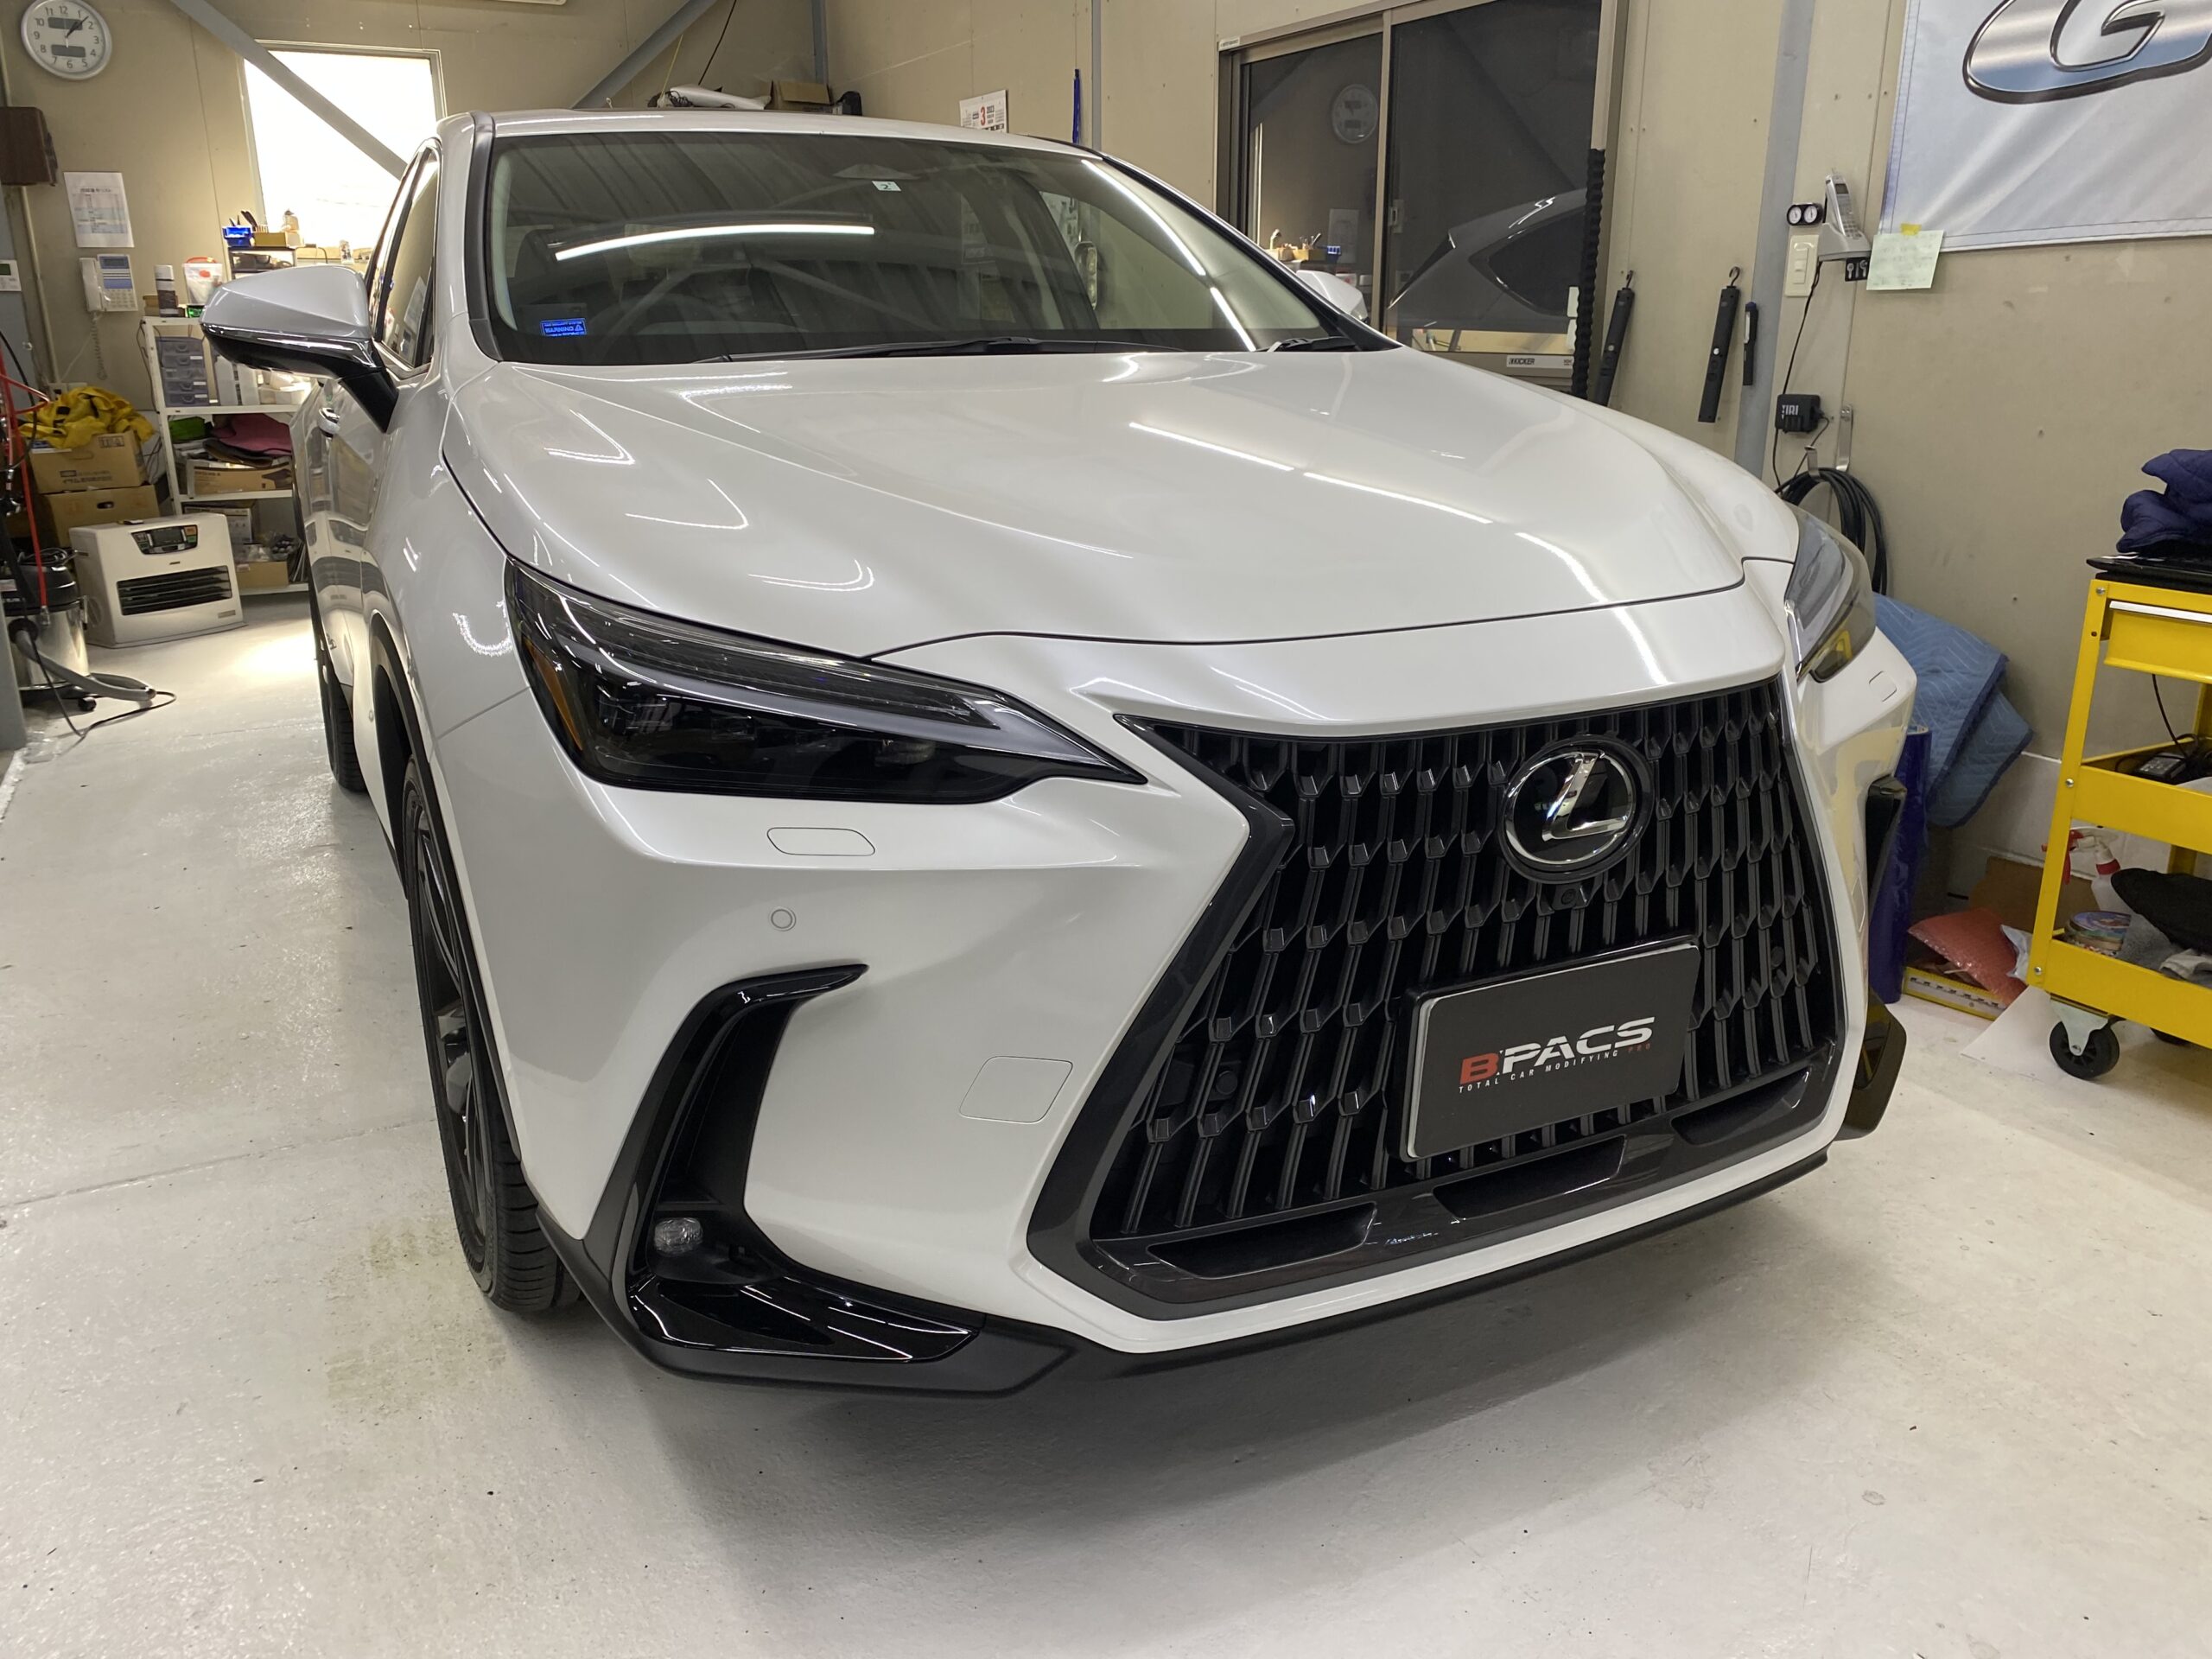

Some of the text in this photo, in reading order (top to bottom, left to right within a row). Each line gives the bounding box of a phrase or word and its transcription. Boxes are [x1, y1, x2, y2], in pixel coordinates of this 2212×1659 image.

[45, 7, 54, 16] 11
[59, 5, 68, 15] 12
[35, 18, 45, 27] 10
[87, 21, 94, 29] 2
[33, 31, 40, 40] 9
[40, 44, 47, 53] 8
[52, 56, 57, 65] 7
[67, 60, 73, 68] 6
[81, 59, 87, 67] 5
[981, 106, 985, 125] 3
[1459, 1016, 1656, 1084] BPACS
[1459, 1043, 1651, 1094] TOTAL CAR MODIFYING PRO
